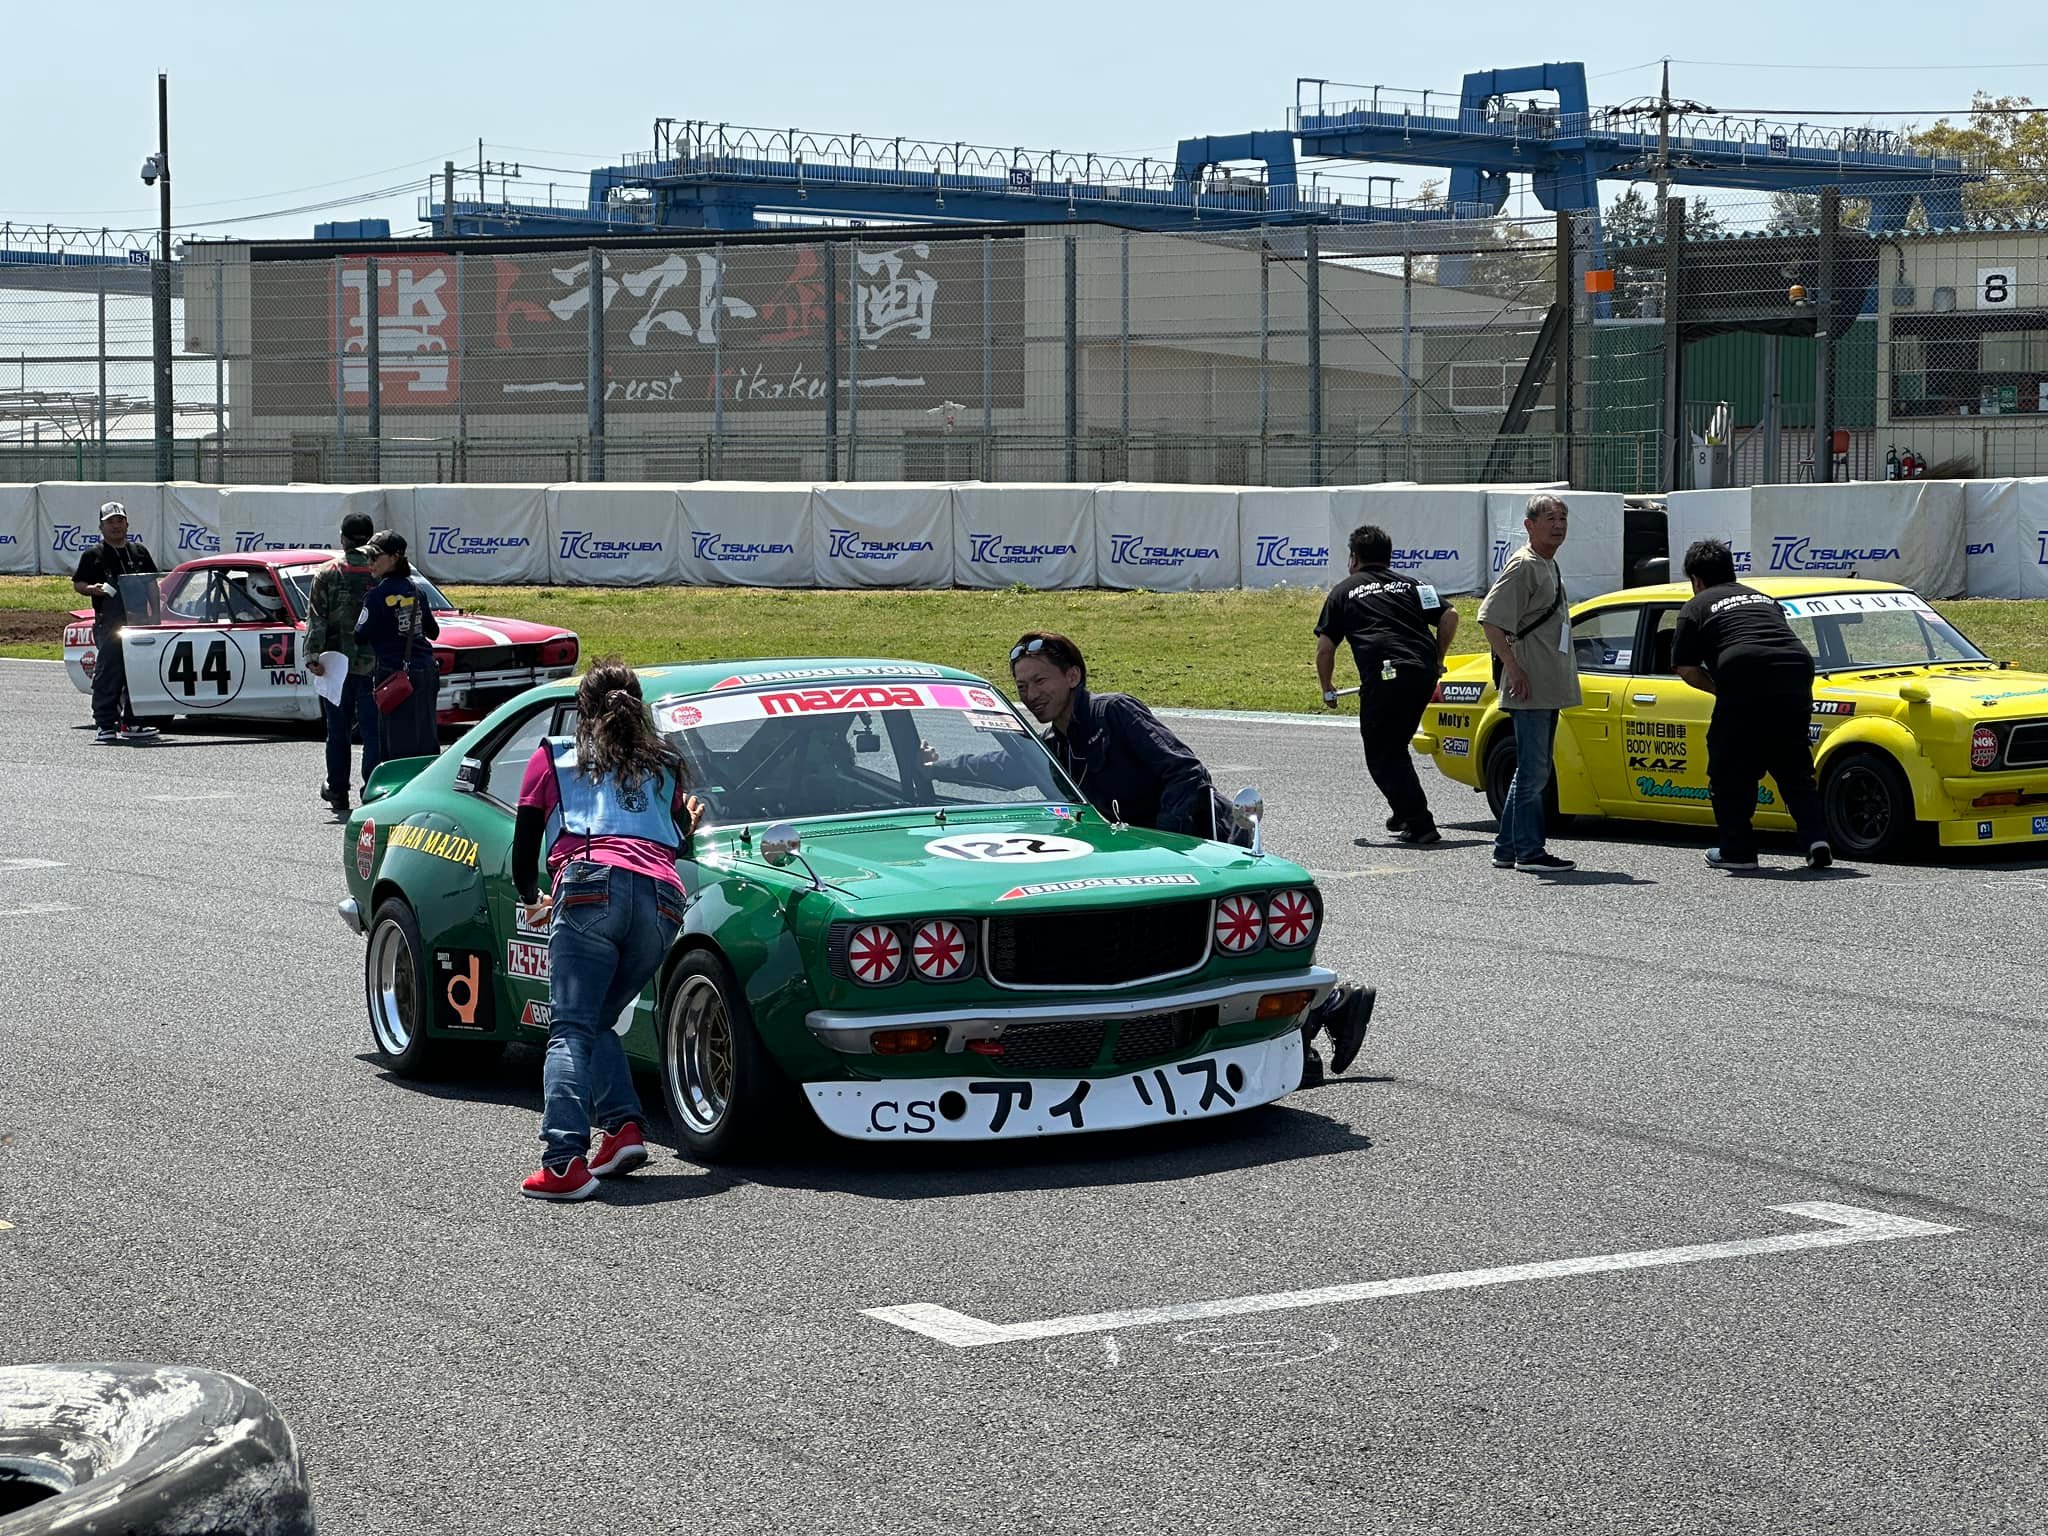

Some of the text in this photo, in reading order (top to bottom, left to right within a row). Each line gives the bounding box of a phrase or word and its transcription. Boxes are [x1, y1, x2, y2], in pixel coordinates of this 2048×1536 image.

[1984, 273, 2008, 303] 8
[604, 367, 683, 400] rust
[81, 534, 143, 544] TSUBA
[460, 537, 530, 547] TSUKUBA
[592, 541, 662, 551] TSUKUBA
[721, 544, 794, 553] TSUKUBA
[861, 541, 933, 551] TSUKUBA
[1003, 544, 1077, 554] TSUKUBA
[589, 551, 629, 559] CIRCUIT
[1144, 547, 1219, 558] TSUKUBA
[1391, 549, 1459, 560] SUKUBA
[1809, 548, 1900, 560] TSUKUBA
[999, 555, 1043, 564] CIRCUIT
[1139, 558, 1184, 566] CIRCUIT
[1286, 558, 1328, 566] CIRCUIT
[1804, 561, 1855, 570] CIRCUIT
[168, 640, 231, 696] 44
[739, 666, 938, 684] BRIDGESTONE
[1443, 686, 1481, 696] ADVAN
[1438, 712, 1470, 728] Moty's
[1453, 739, 1468, 751] PSW
[1627, 739, 1687, 756] BODY WORKS
[1974, 737, 1994, 747] NGK
[1629, 757, 1687, 770] KAZ
[1636, 776, 1713, 801] Nakamur
[421, 830, 479, 867] MAZDA
[935, 838, 1070, 860] 122
[1023, 874, 1192, 896] BRIDGESTONE
[870, 1100, 936, 1134] CS
